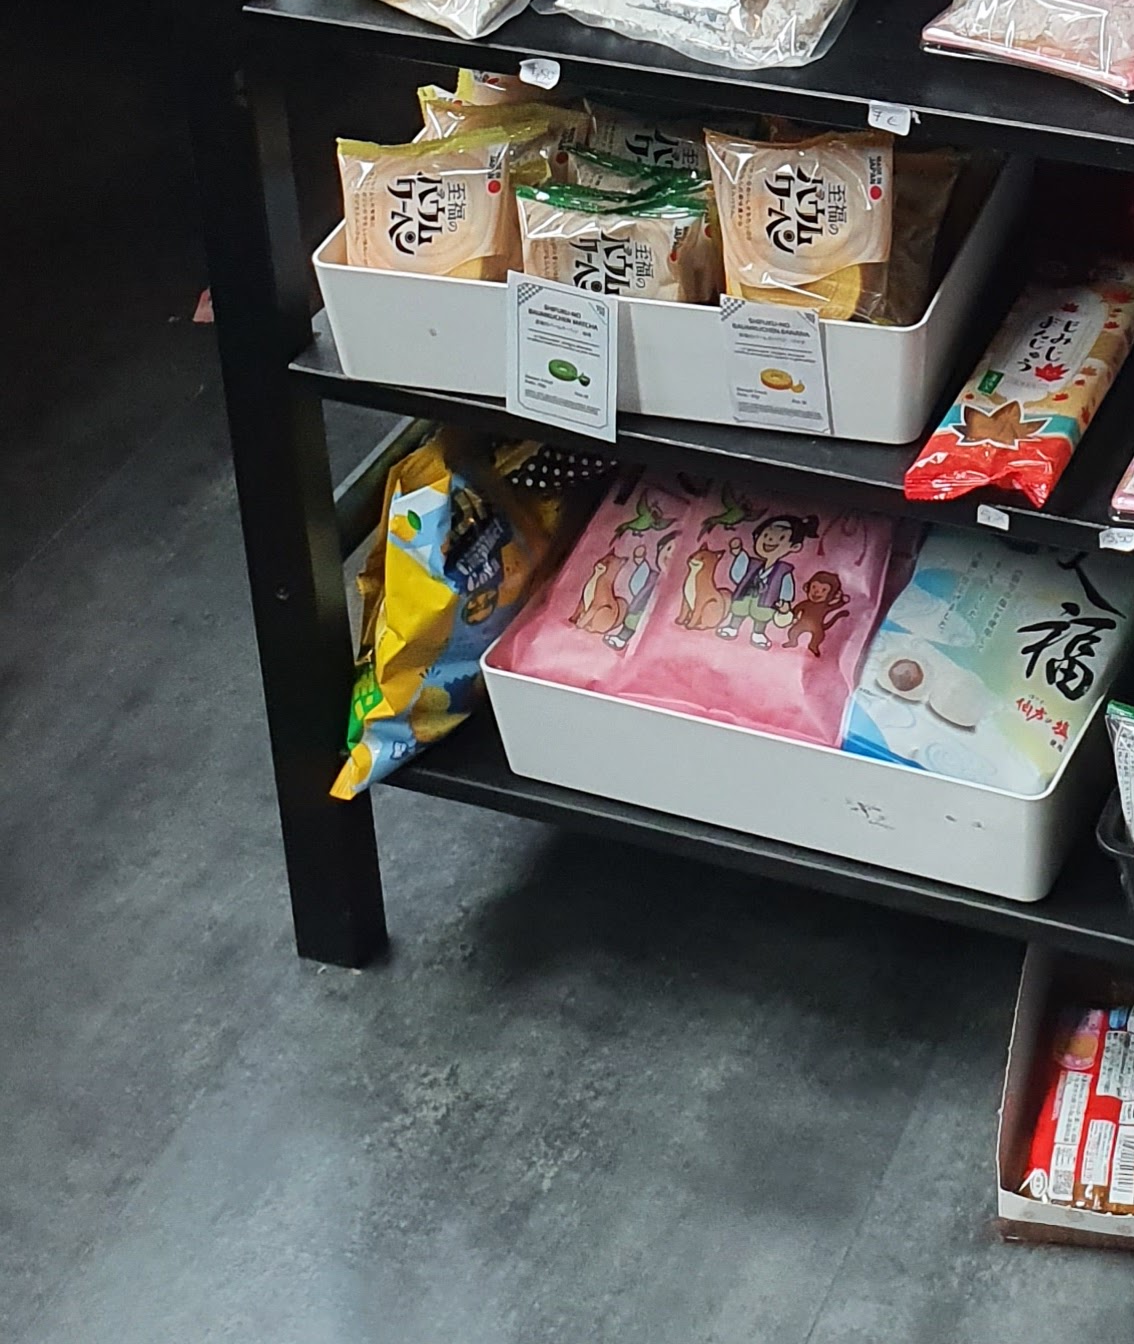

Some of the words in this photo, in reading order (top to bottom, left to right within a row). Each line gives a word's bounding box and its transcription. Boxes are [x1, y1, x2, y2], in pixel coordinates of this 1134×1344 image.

[387, 177, 417, 255] クーヘン
[447, 181, 466, 232] 至福の
[765, 172, 795, 254] クーヘン
[828, 183, 847, 235] 至福の
[635, 241, 653, 288] 至福の
